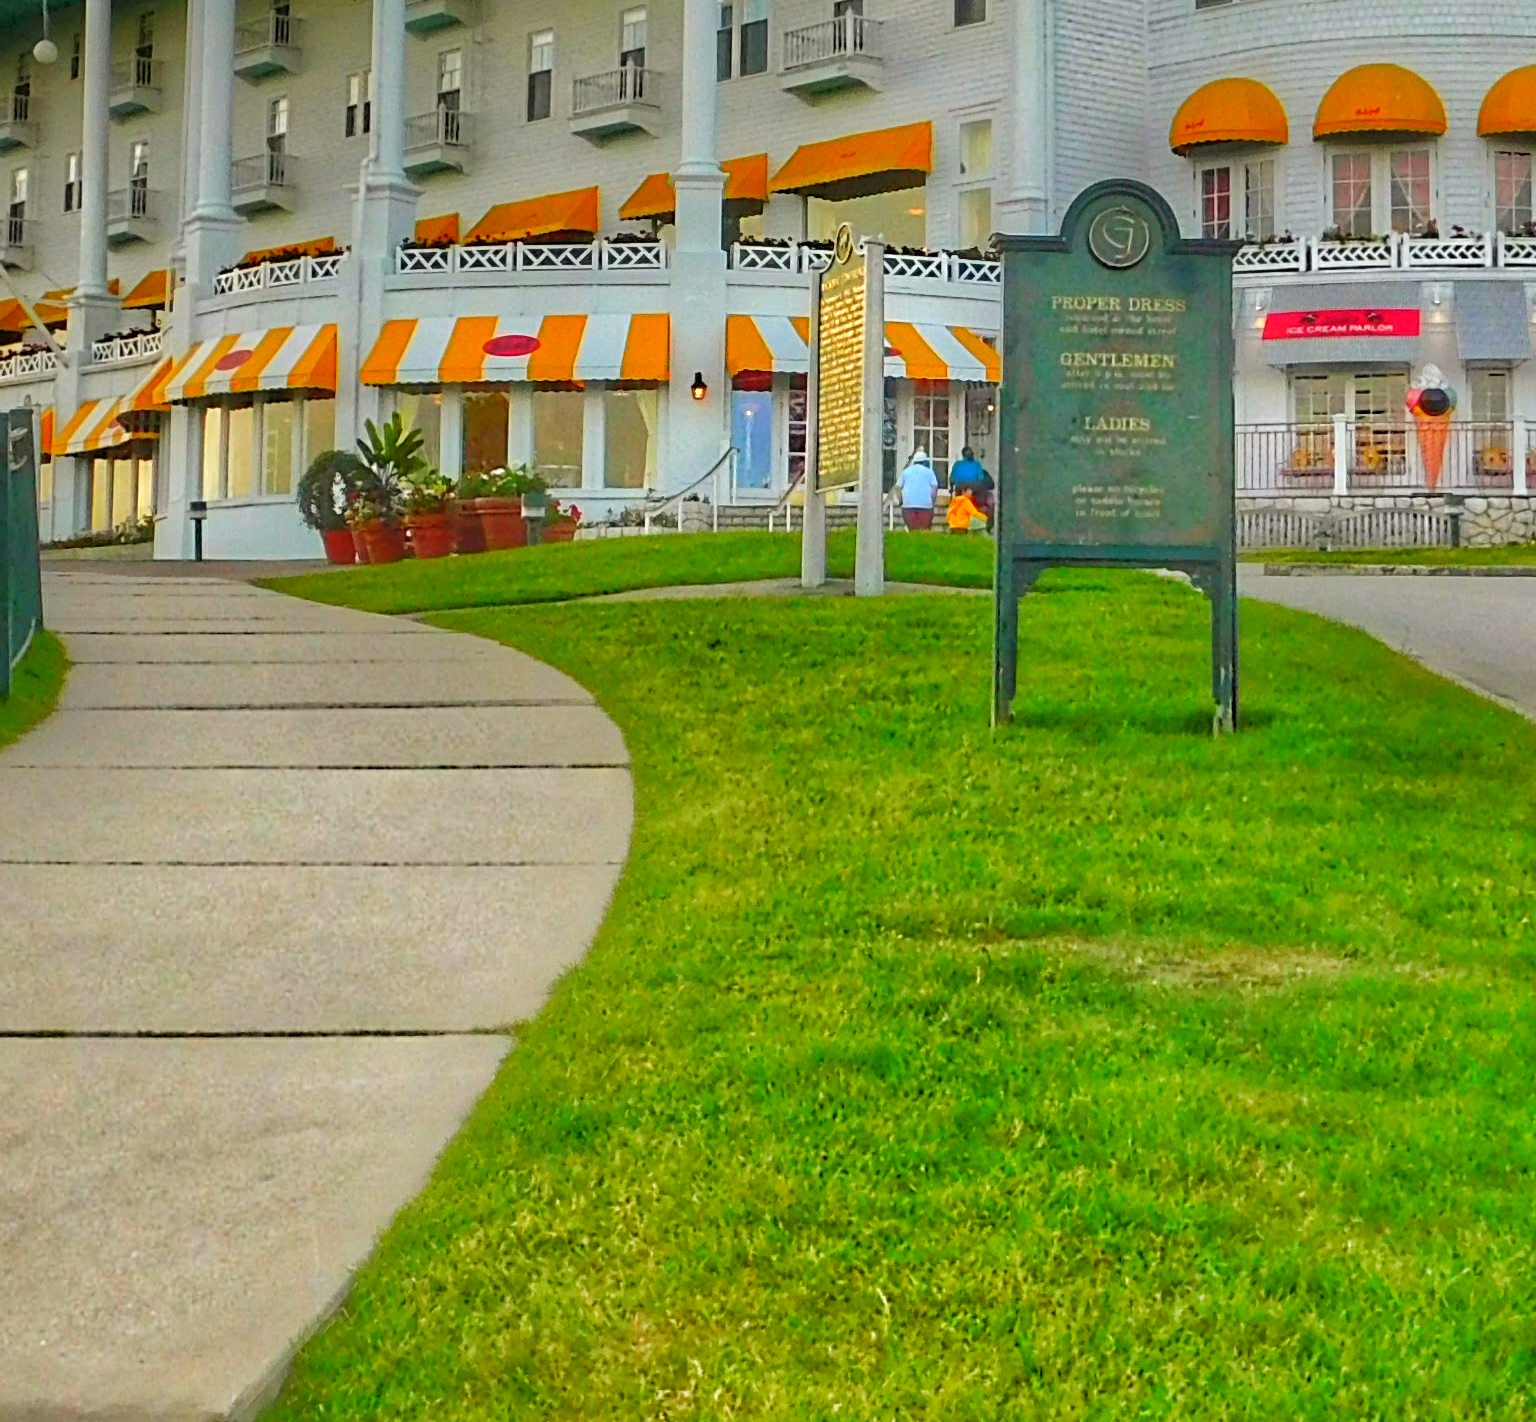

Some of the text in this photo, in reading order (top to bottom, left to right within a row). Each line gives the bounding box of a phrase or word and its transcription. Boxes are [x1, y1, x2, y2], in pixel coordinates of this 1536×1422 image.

[1050, 295, 1186, 312] PROPER DRESS
[1286, 323, 1394, 334] ICE CREAM PARLOR
[1060, 352, 1176, 368] GENTLEMEN
[1084, 416, 1151, 431] LADIES
